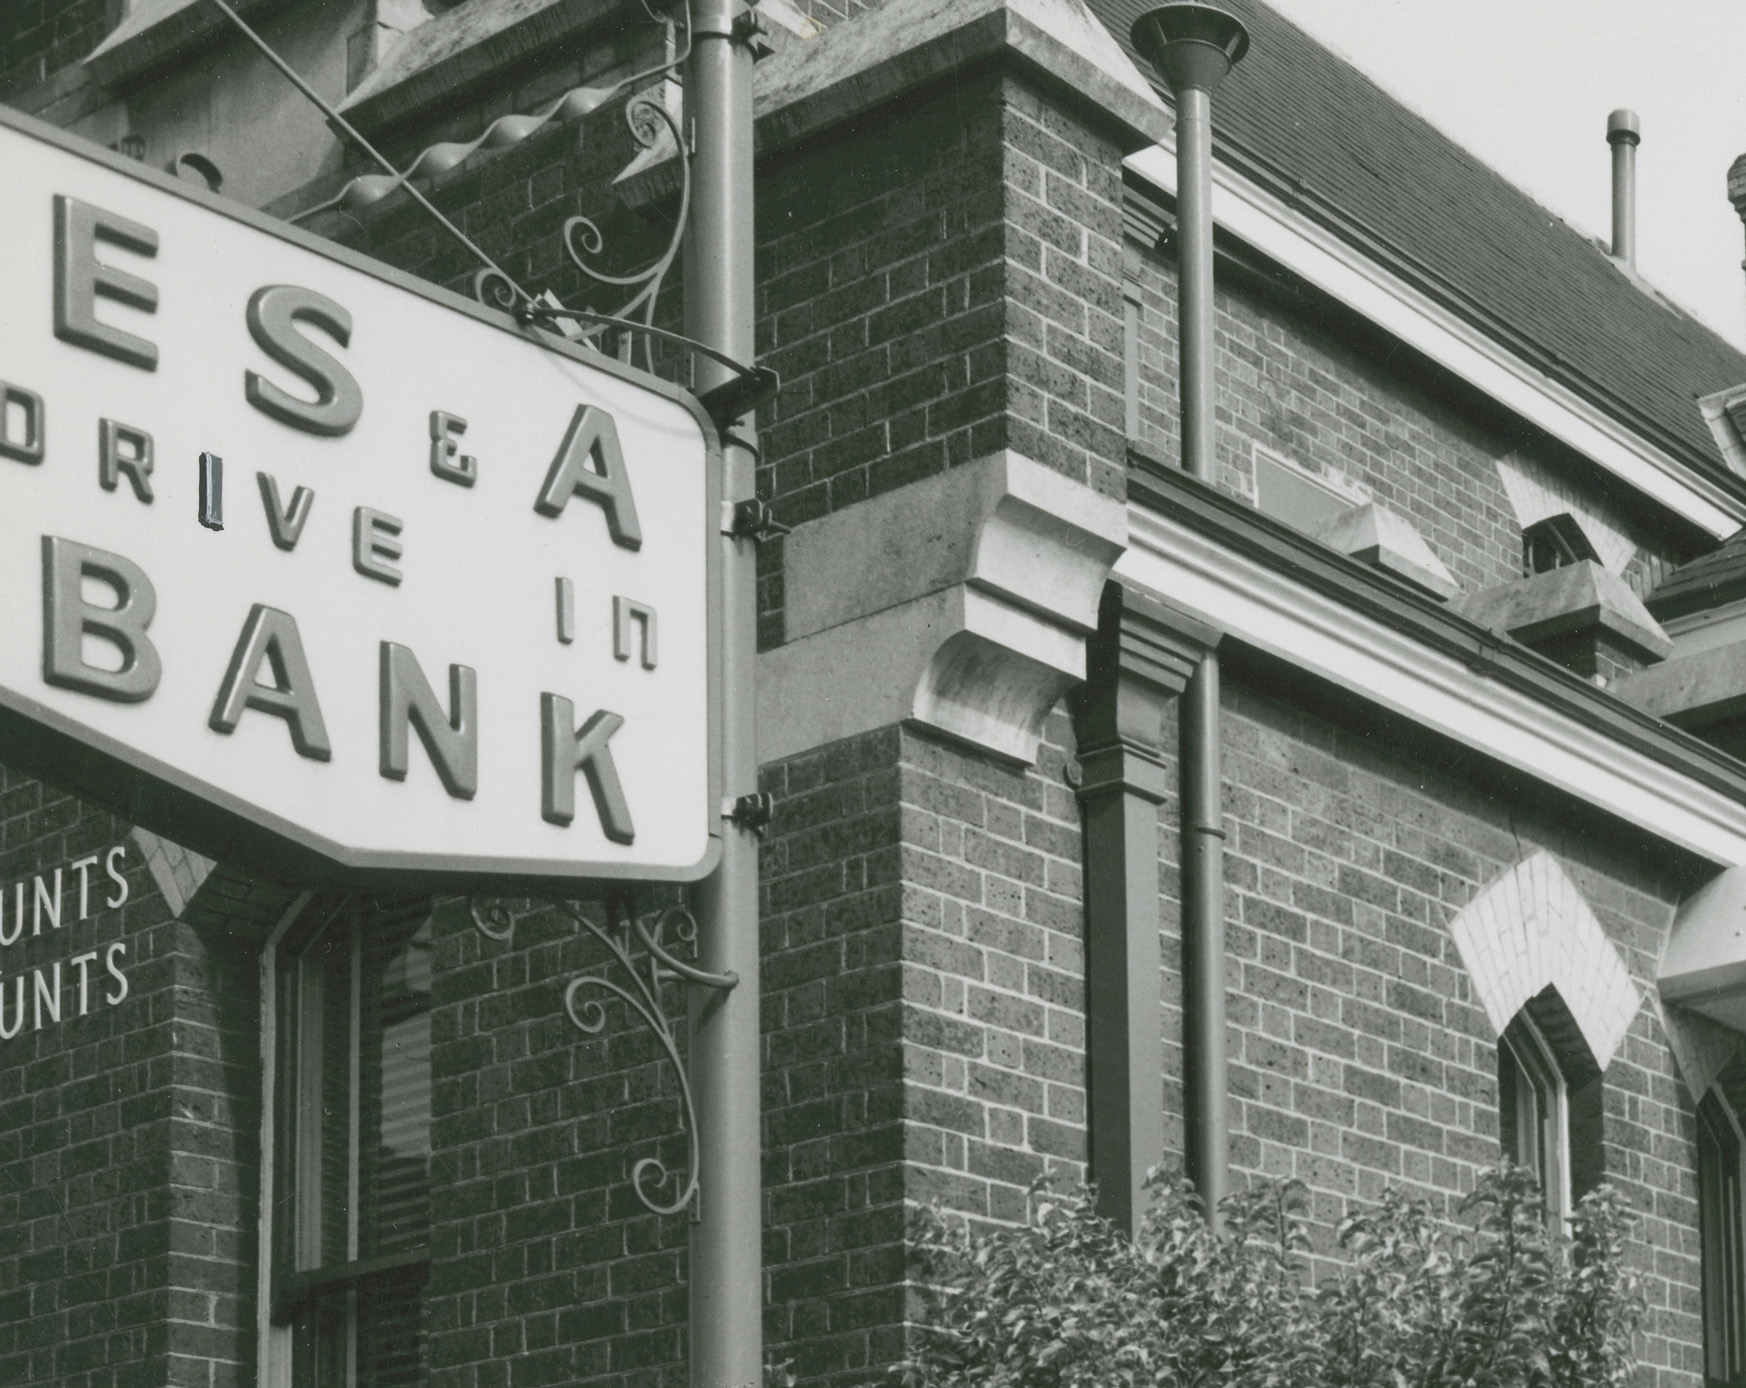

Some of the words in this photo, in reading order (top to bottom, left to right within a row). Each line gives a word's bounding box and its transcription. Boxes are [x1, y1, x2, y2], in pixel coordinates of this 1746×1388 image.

[0, 380, 403, 586] DRIVE
[41, 535, 634, 846] BANK
[0, 846, 129, 946] UNTS
[0, 942, 129, 1040] UNTS
